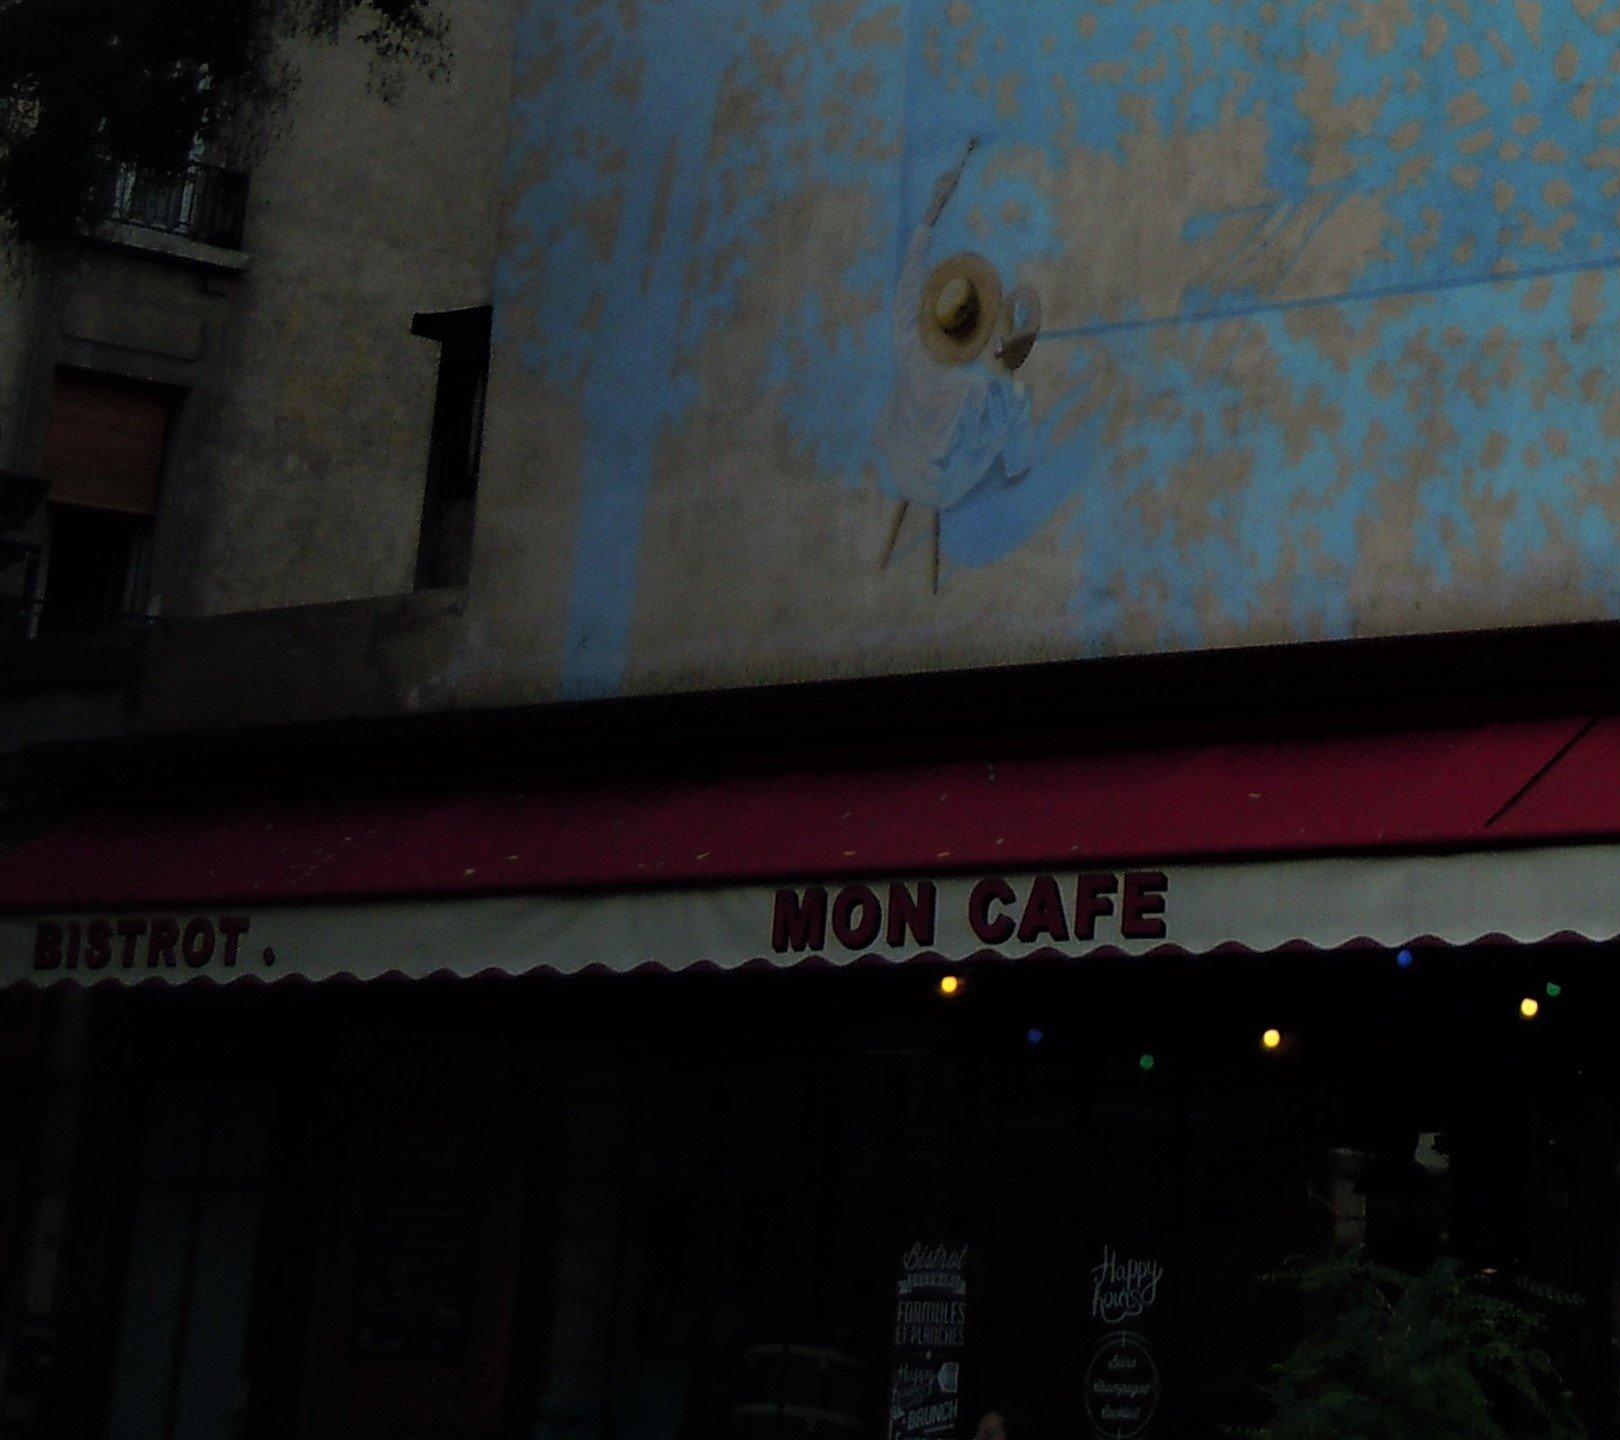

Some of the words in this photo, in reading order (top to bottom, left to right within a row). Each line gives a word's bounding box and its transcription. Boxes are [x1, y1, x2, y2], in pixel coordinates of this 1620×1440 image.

[772, 877, 938, 953] MON
[968, 871, 1169, 944] CAFE
[1090, 1244, 1164, 1305] Happy
